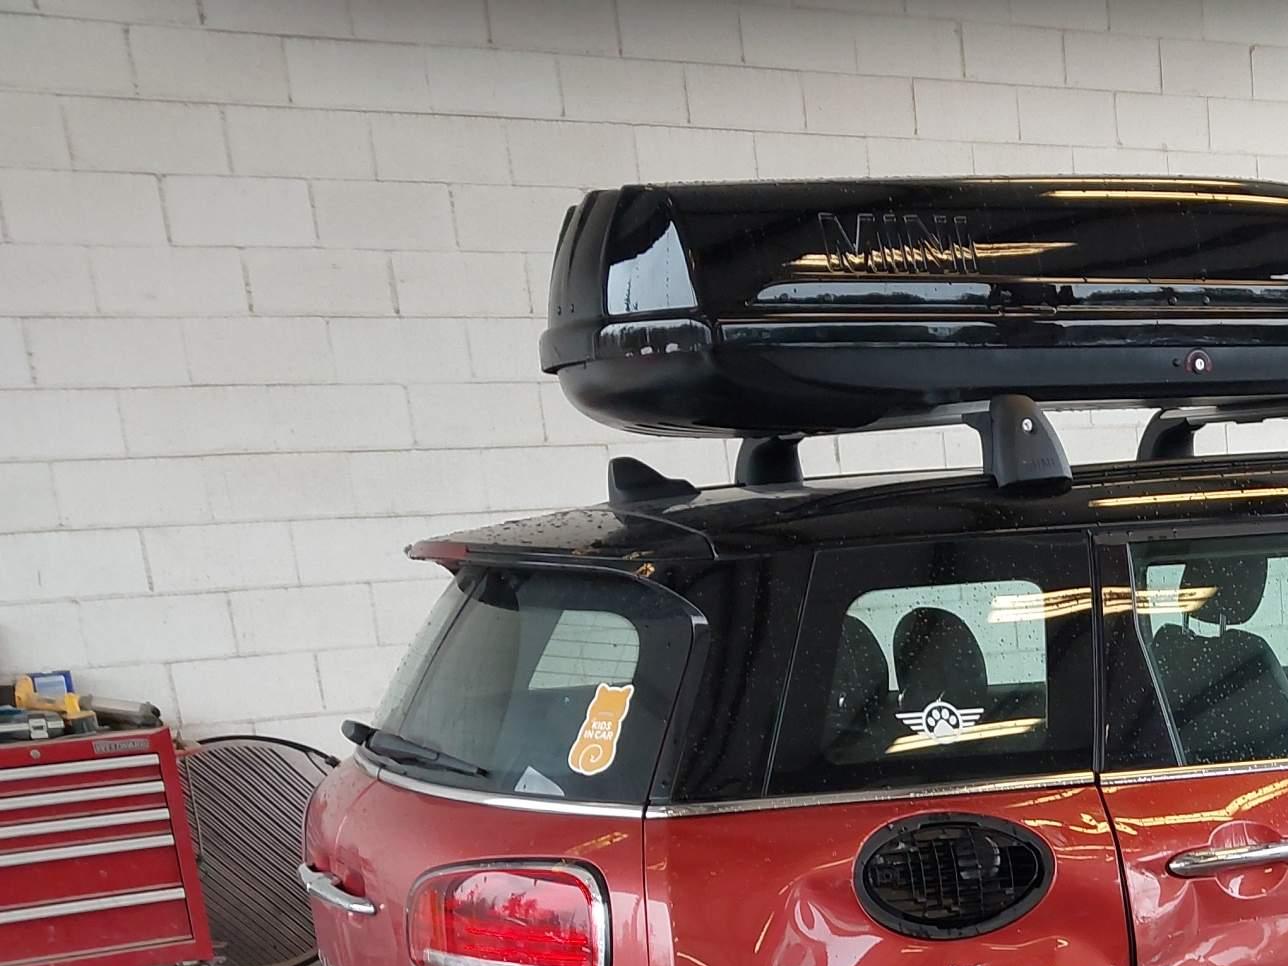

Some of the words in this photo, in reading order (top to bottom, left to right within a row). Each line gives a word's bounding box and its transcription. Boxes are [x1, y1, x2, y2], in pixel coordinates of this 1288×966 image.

[818, 211, 980, 275] MINI
[590, 720, 612, 731] KIDS
[583, 730, 594, 739] IN
[595, 731, 614, 741] CAR
